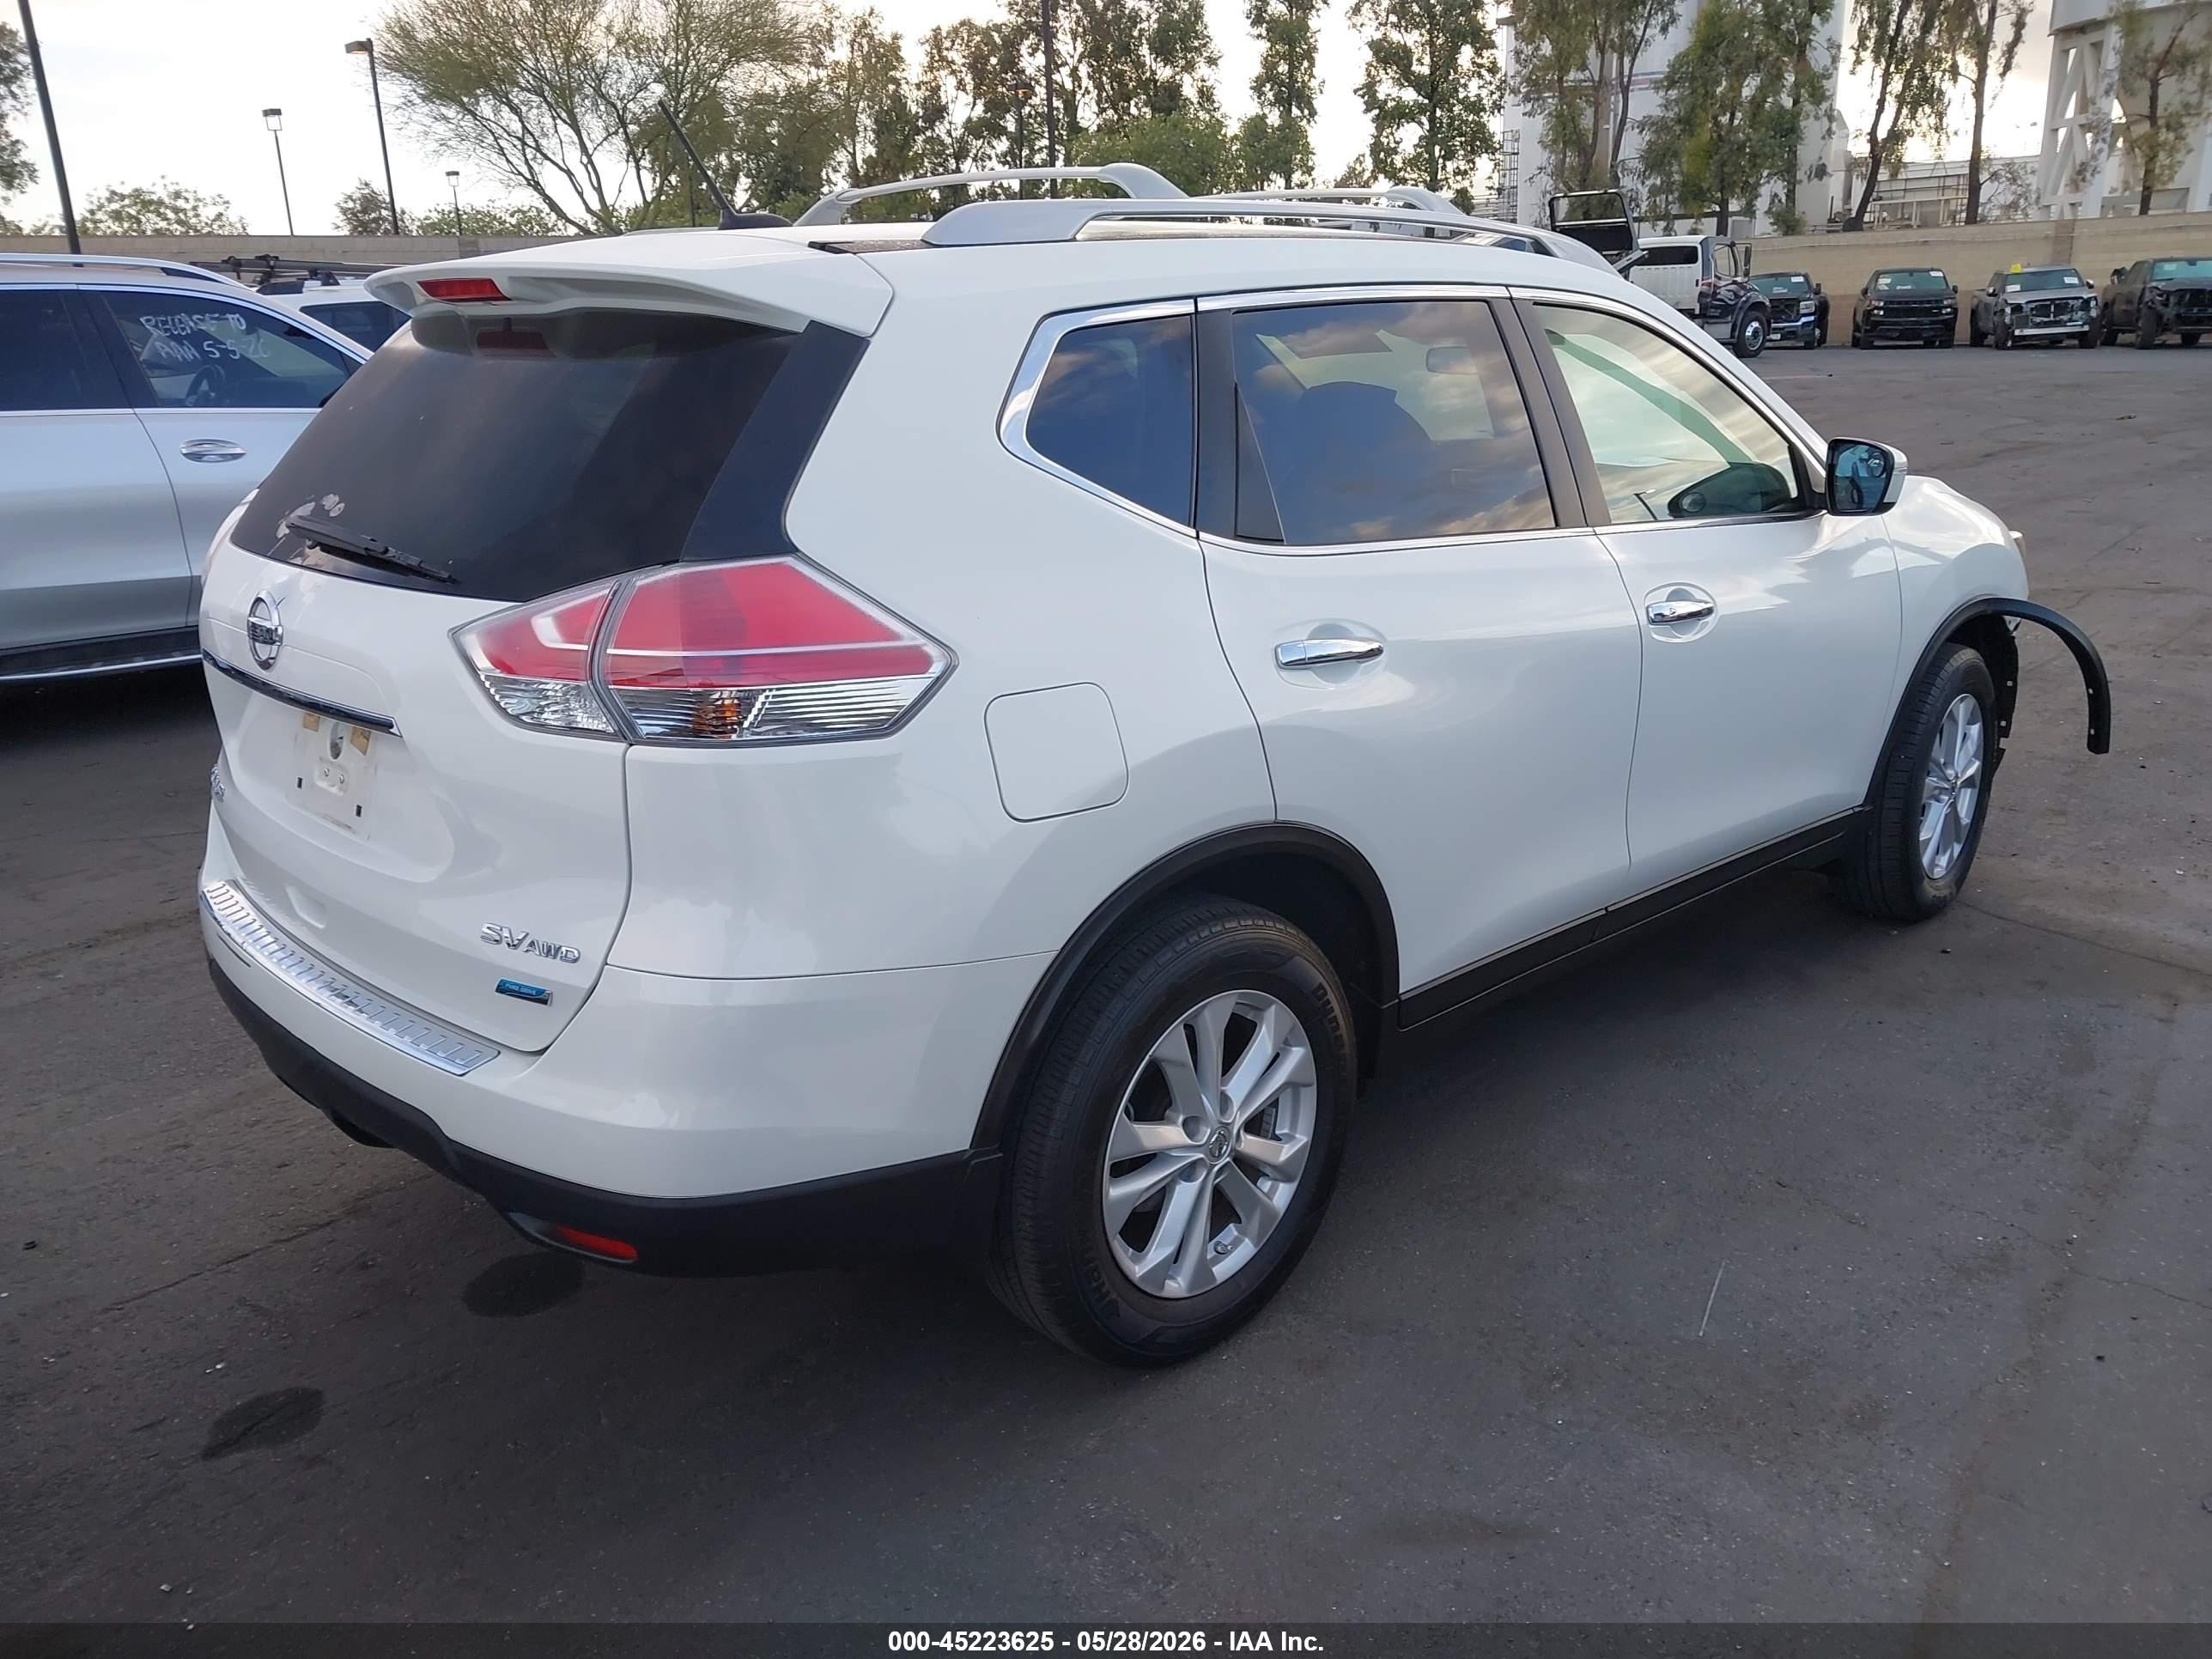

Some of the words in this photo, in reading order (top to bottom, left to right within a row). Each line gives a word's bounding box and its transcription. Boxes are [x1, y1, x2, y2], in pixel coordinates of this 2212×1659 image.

[225, 313, 246, 331] TO
[480, 922, 530, 951] SV
[522, 938, 580, 963] AWD
